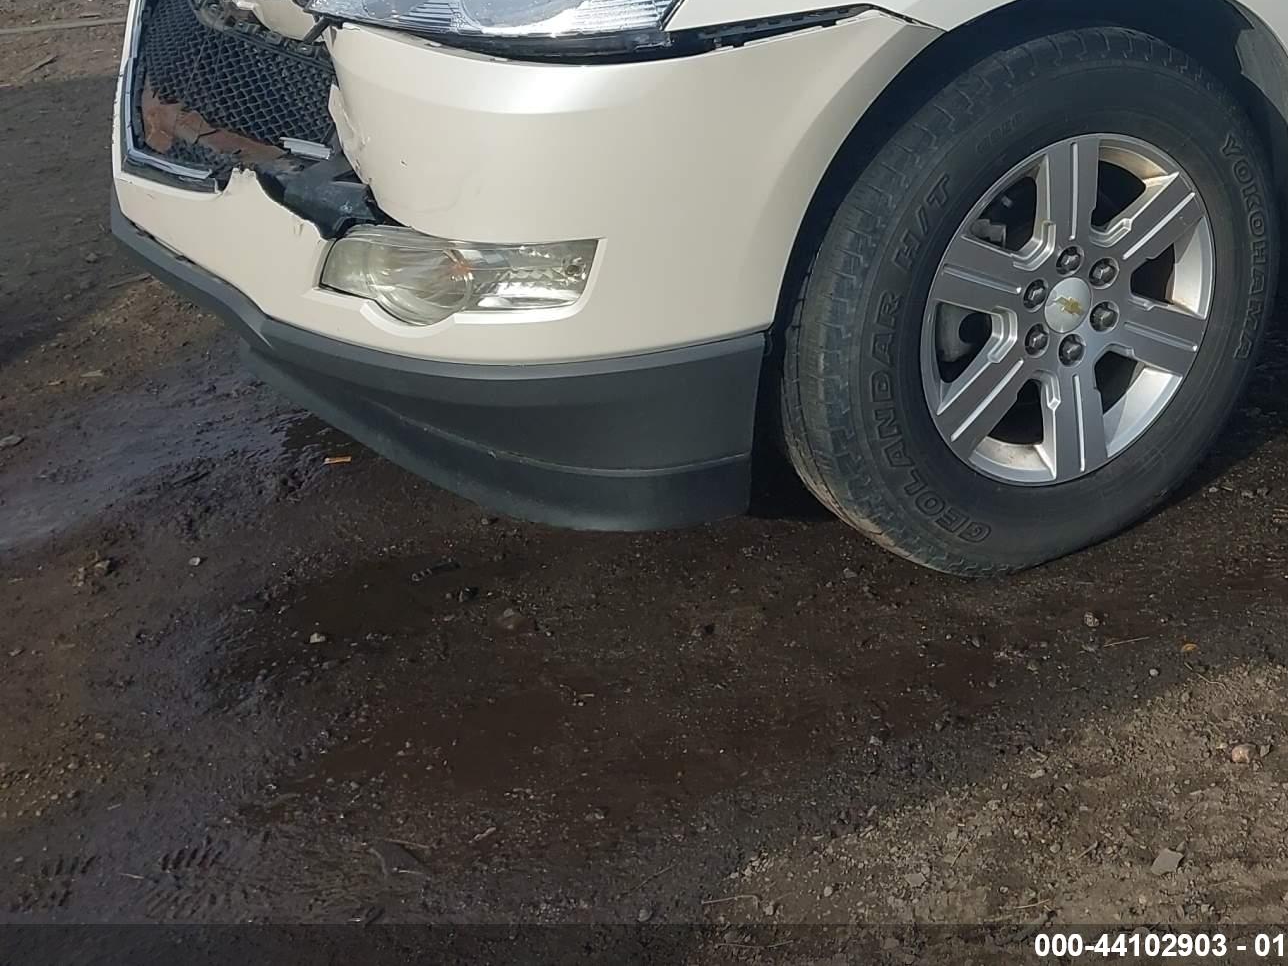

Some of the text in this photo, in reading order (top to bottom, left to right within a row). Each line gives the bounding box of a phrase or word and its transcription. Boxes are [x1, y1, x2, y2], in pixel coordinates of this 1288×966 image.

[866, 170, 994, 545] GEOLANDAR H/T
[1222, 133, 1274, 362] YOKOHAMA
